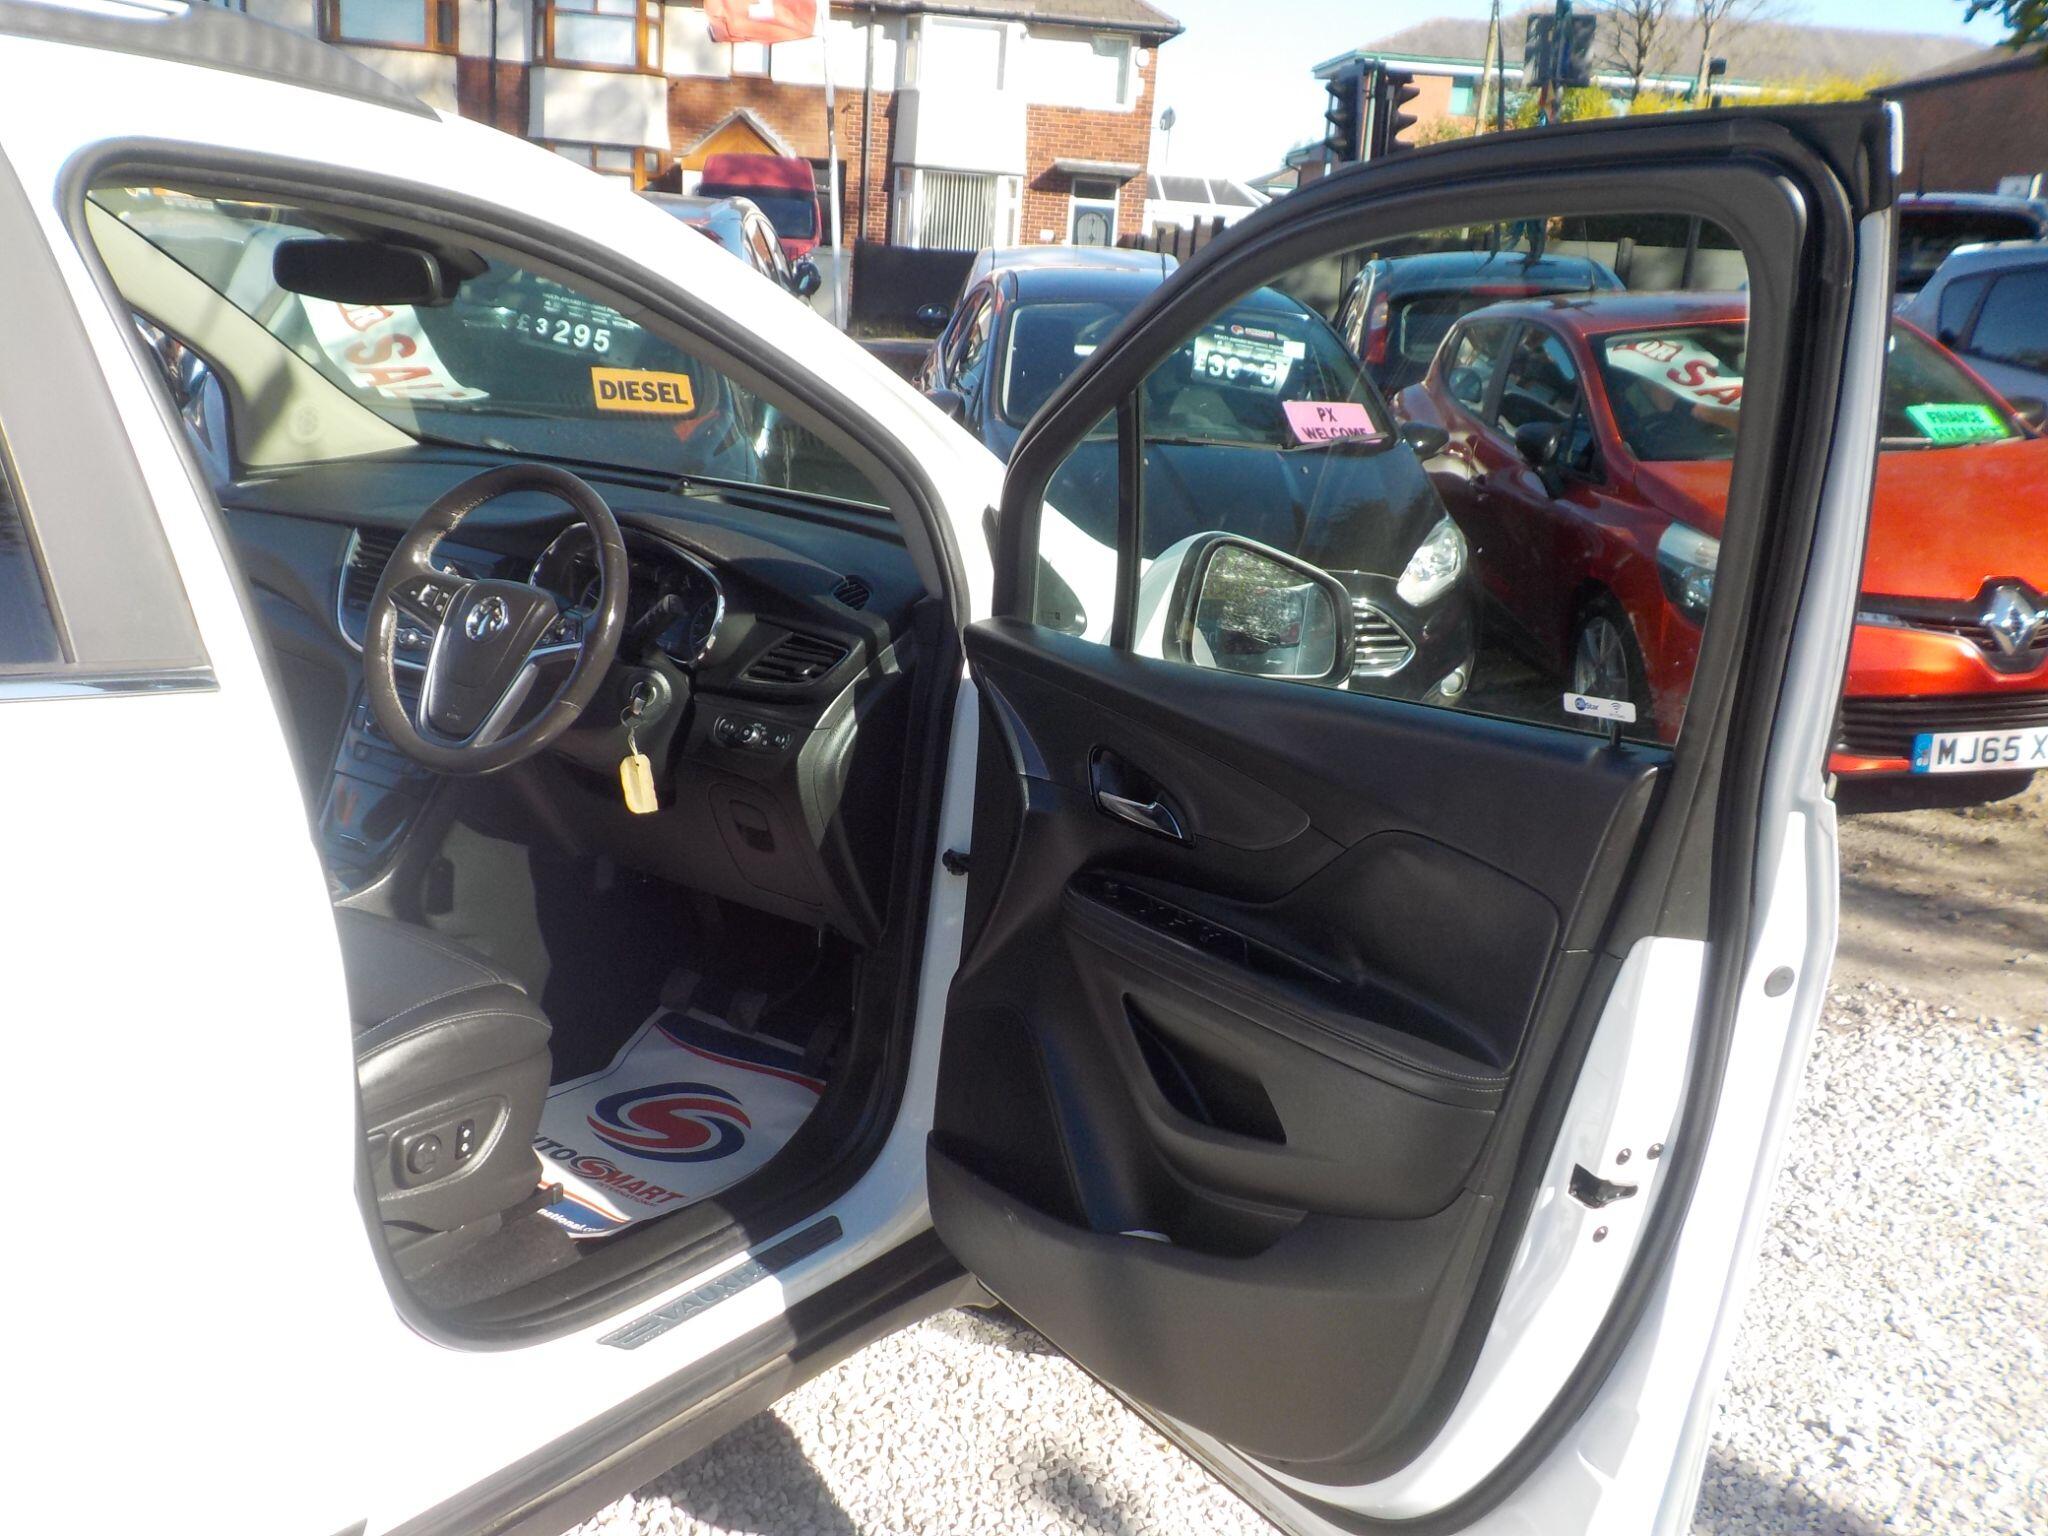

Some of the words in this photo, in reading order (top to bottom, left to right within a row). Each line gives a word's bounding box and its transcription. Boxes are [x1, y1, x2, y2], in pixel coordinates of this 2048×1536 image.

[598, 379, 689, 405] DIESEL
[1316, 406, 1338, 423] PX
[1301, 426, 1367, 440] WELCOME
[1937, 736, 2022, 765] MJ65
[2030, 733, 2048, 760] X
